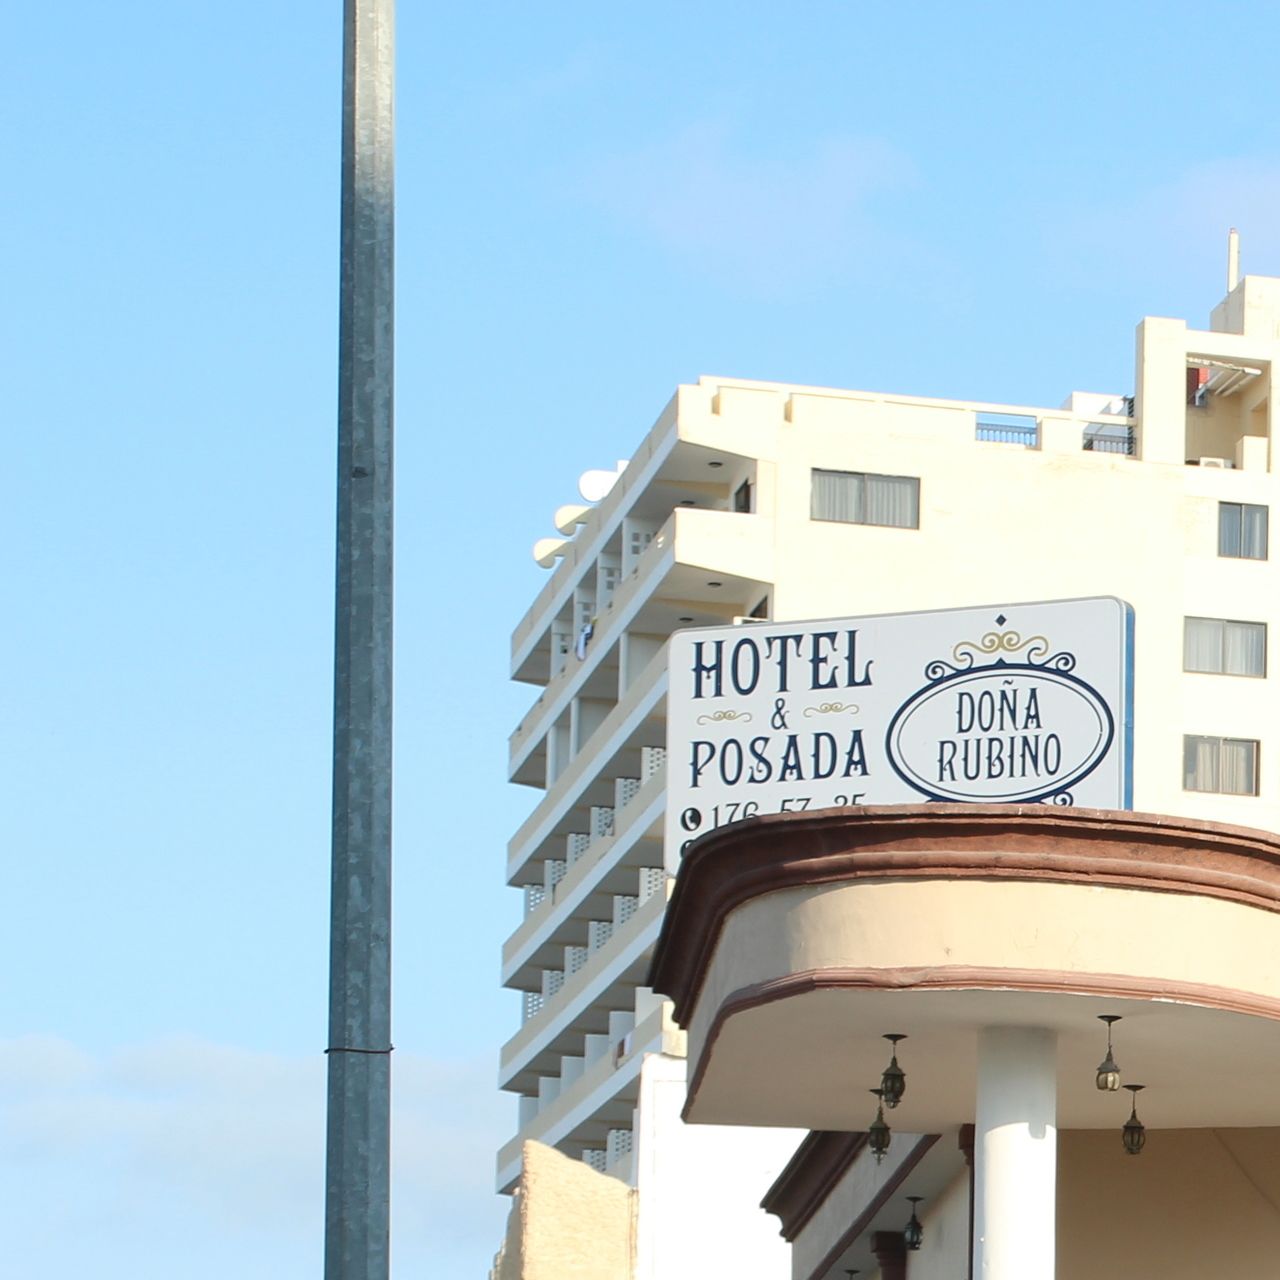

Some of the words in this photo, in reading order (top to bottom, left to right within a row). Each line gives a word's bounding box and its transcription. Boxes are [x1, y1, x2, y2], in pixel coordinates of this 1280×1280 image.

[691, 630, 873, 699] HOTEL
[770, 697, 790, 730] &
[956, 680, 1042, 734] DOÑA
[690, 729, 870, 788] POSADA
[937, 732, 1062, 783] RUBINO
